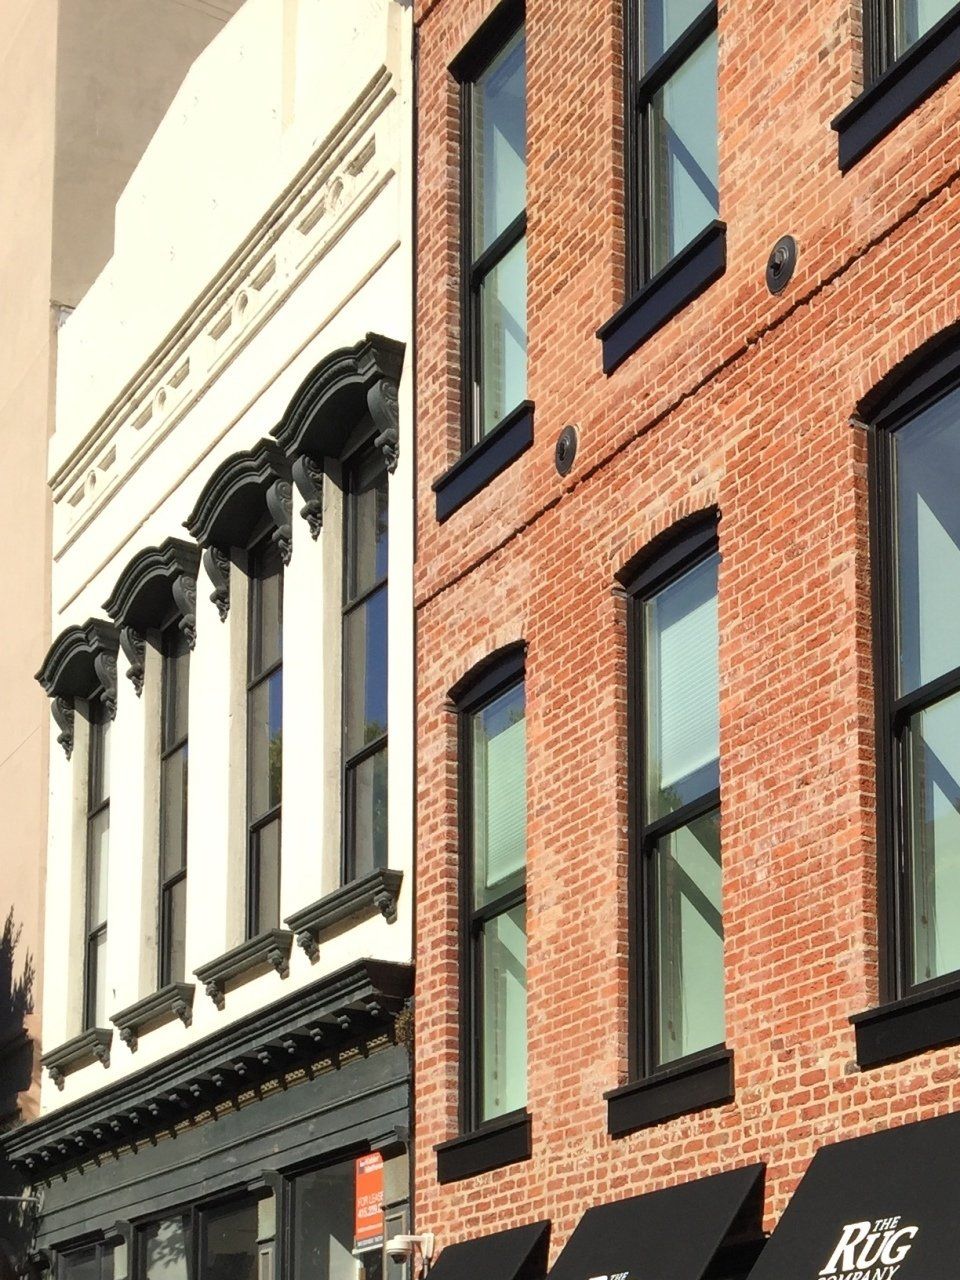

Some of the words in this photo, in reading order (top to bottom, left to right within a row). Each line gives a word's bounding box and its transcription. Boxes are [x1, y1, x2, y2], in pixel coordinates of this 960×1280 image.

[357, 1194, 369, 1207] FOR
[369, 1190, 384, 1205] LEASE
[872, 1215, 901, 1232] THE
[818, 1221, 919, 1275] RUG
